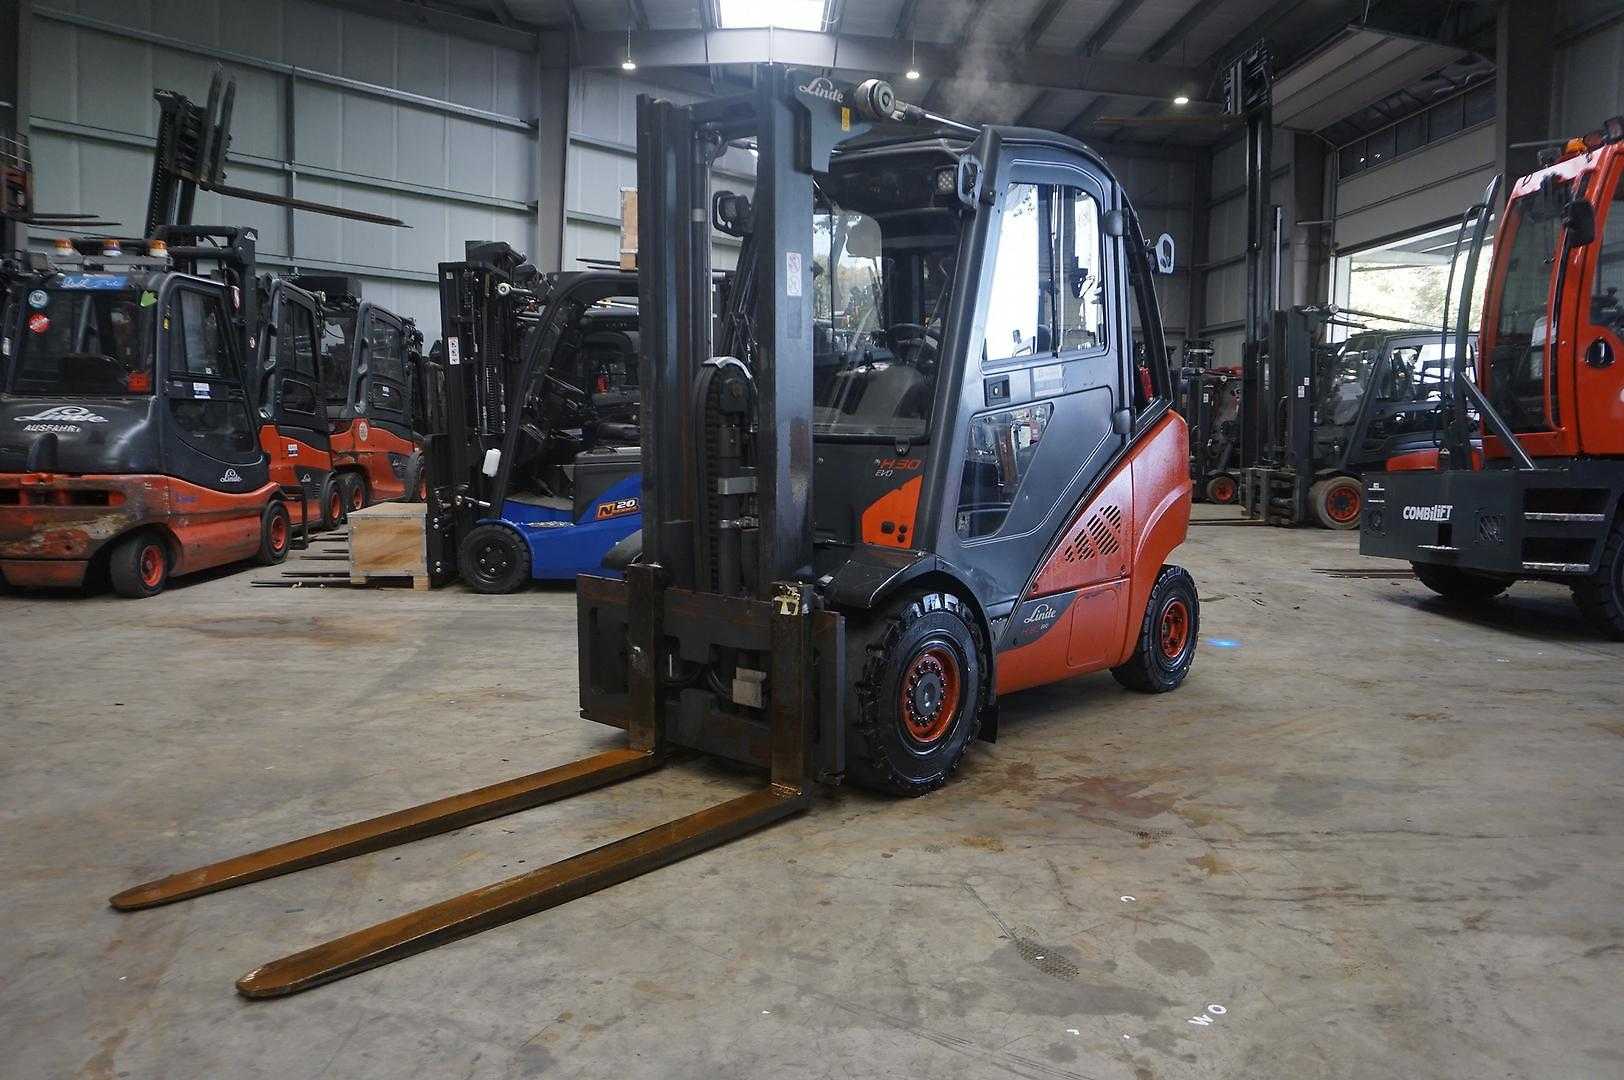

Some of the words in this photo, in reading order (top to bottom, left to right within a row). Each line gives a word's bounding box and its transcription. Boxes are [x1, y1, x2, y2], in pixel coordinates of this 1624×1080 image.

[798, 77, 844, 103] Linde
[13, 405, 109, 422] Linde
[1023, 603, 1057, 624] Linde
